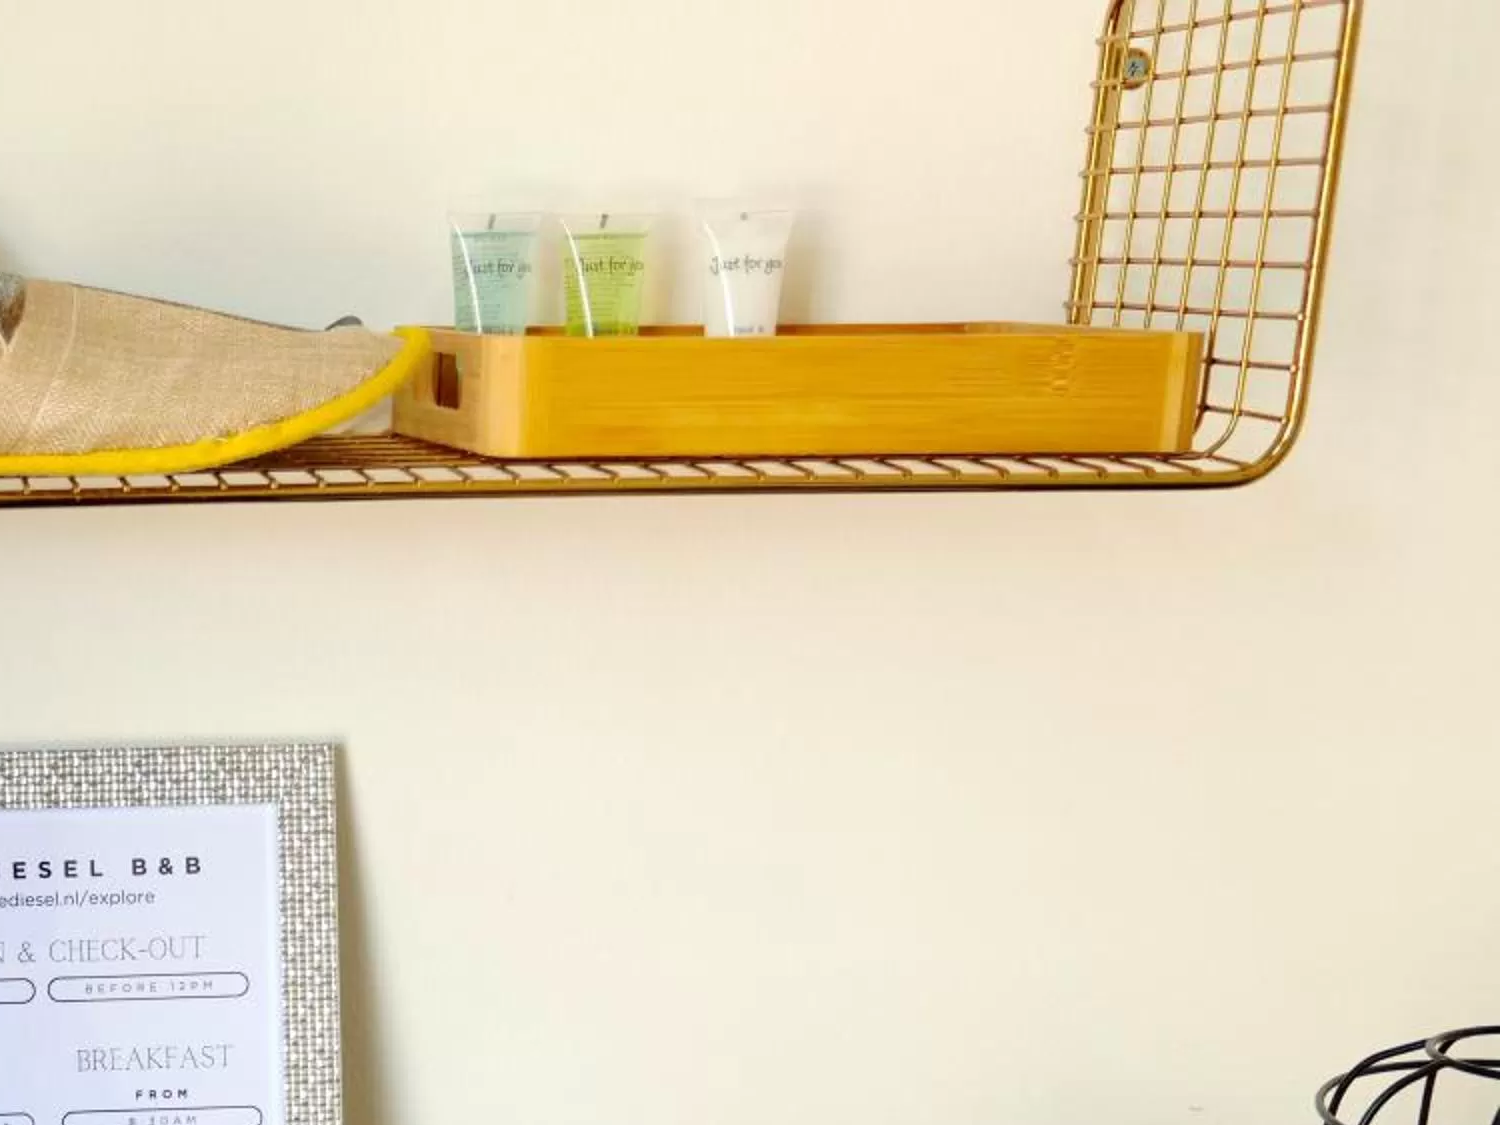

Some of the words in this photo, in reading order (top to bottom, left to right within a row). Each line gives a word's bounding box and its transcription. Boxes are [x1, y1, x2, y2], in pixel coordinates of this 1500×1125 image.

[743, 254, 761, 275] for
[131, 856, 203, 876] B&B
[17, 941, 36, 963] &
[48, 935, 207, 963] CHECK-OUT
[84, 981, 159, 995] BEFORE
[169, 979, 215, 992] 12PM
[76, 1043, 235, 1073] BREAKFAST
[135, 1089, 188, 1101] FROM
